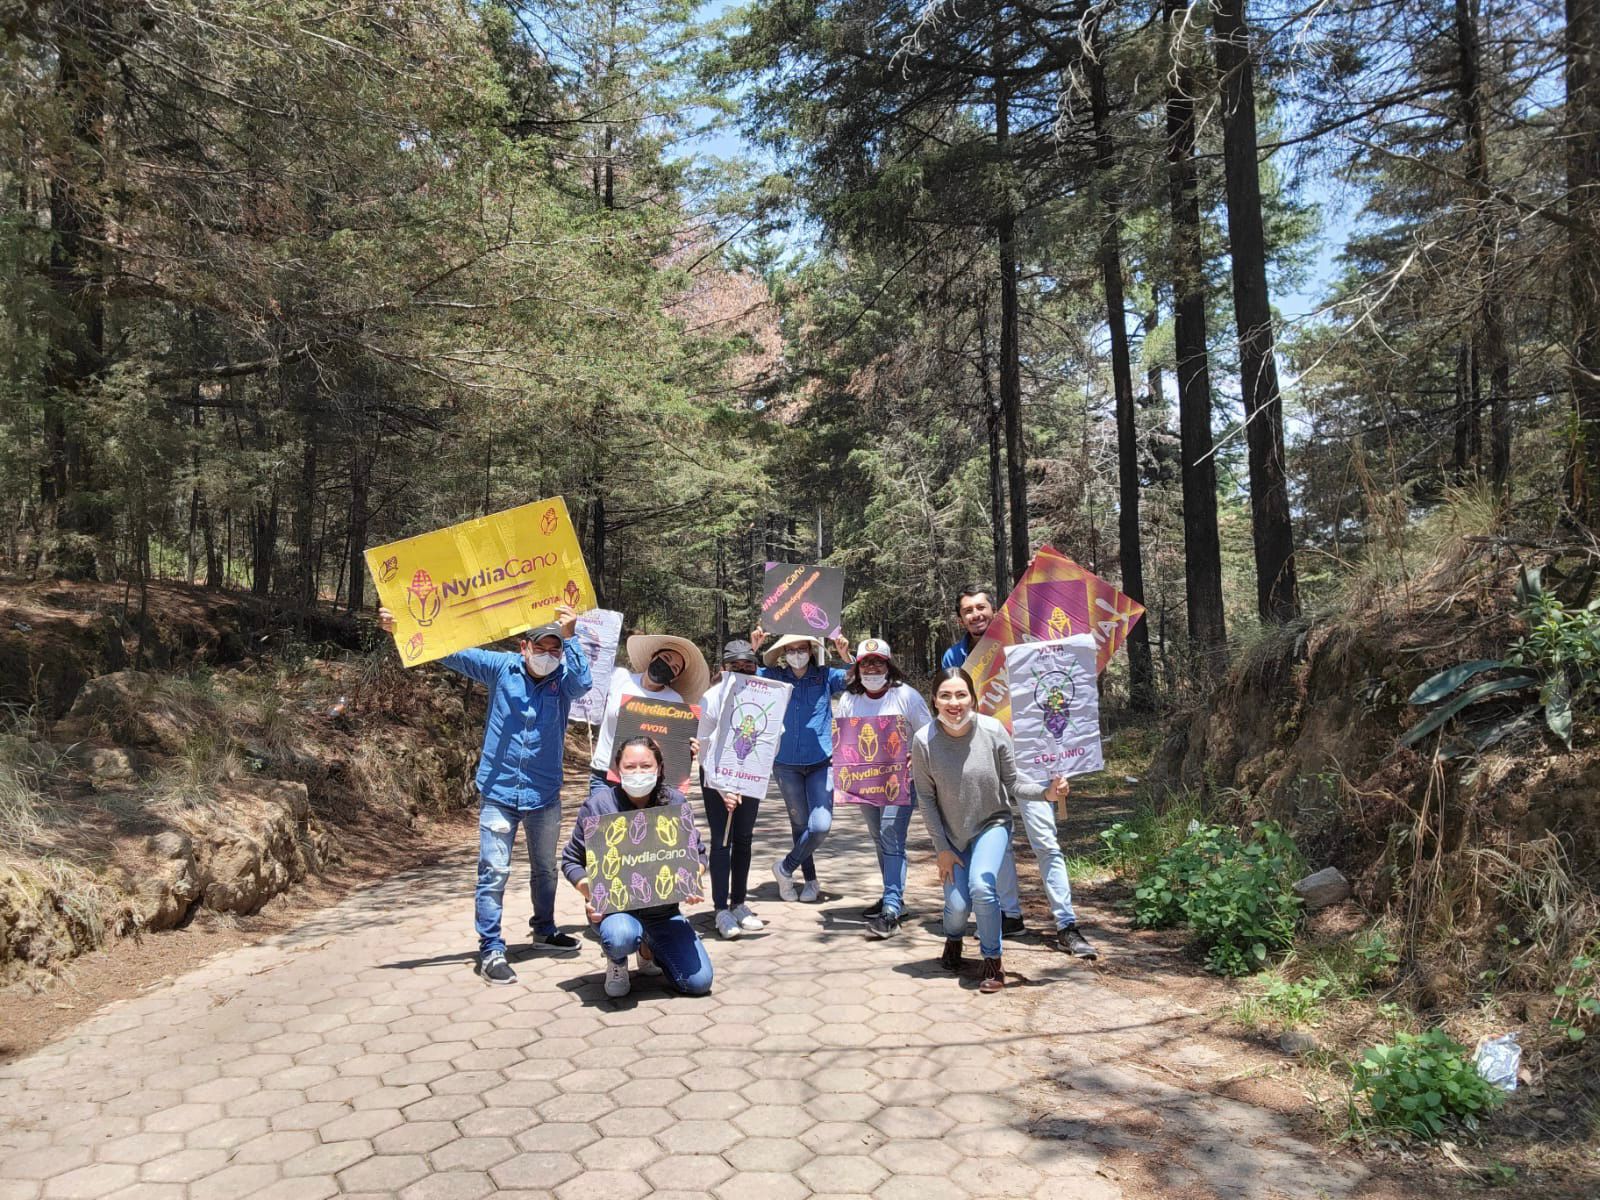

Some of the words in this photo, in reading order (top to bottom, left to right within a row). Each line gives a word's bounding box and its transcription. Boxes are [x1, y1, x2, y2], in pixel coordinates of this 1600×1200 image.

[441, 551, 558, 599] NydiaCano
[762, 565, 805, 612] #NydiaCano
[745, 679, 768, 690] VOTA
[625, 701, 695, 719] #NydiaCano
[640, 721, 667, 735] #VOTA
[1042, 753, 1057, 763] DE
[1058, 747, 1085, 762] JUNIO
[721, 767, 733, 777] DE
[734, 770, 761, 783] JUNIO
[850, 763, 902, 781] NydiaCano
[859, 786, 885, 795] #VOTA
[621, 848, 686, 867] NydiaCano
